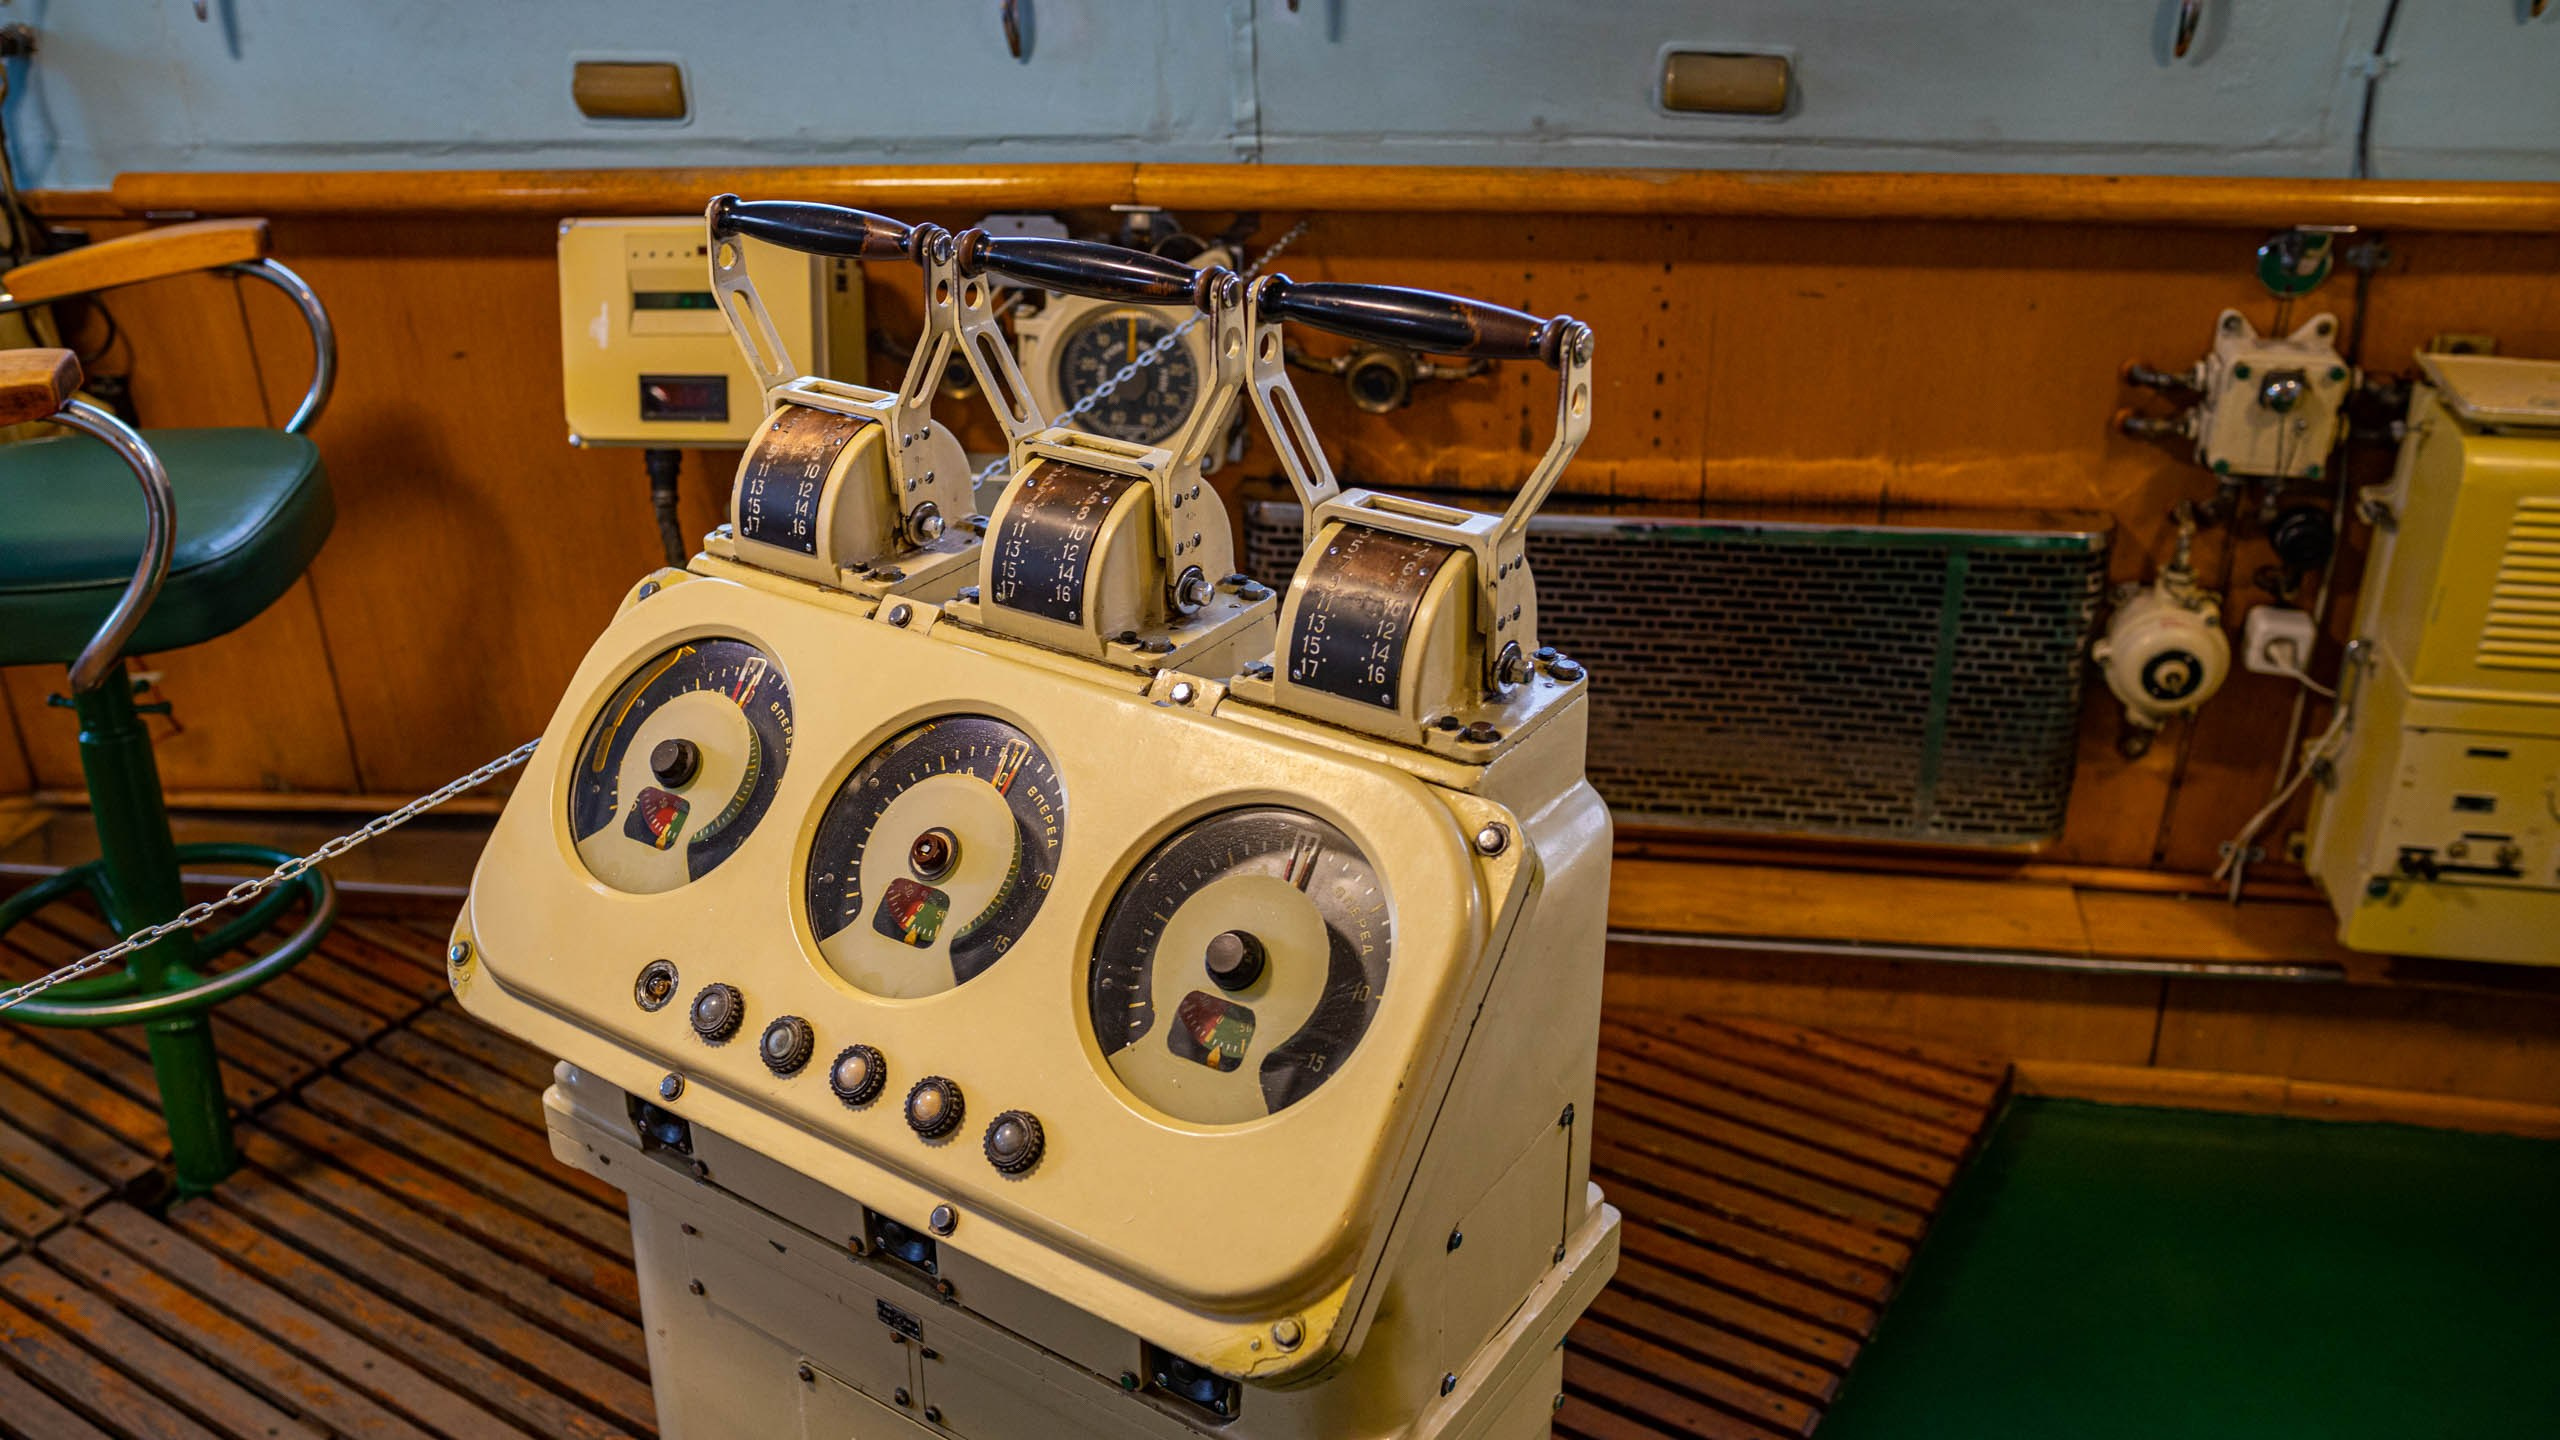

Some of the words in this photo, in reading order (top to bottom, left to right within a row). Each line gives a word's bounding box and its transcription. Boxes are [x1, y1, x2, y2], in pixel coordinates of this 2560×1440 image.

[758, 463, 769, 476] 11
[803, 463, 820, 479] 10
[751, 479, 765, 496] 13
[798, 482, 813, 498] 12
[748, 498, 761, 514] 15
[795, 500, 809, 516] 14
[1022, 503, 1034, 518] 9
[1076, 506, 1091, 520] 8
[747, 517, 760, 533] 17
[793, 518, 807, 535] 16
[1012, 522, 1026, 538] 11
[1068, 524, 1087, 541] 10
[1005, 541, 1021, 558] 13
[1062, 543, 1079, 561] 12
[1347, 539, 1363, 553] 5
[1414, 547, 1431, 560] 4
[1002, 561, 1017, 578] 15
[1058, 564, 1074, 582] 14
[1402, 562, 1417, 576] 6
[1001, 582, 1016, 598] 17
[1055, 585, 1071, 602] 16
[1383, 598, 1404, 616] 10
[1307, 613, 1327, 633] 13
[1376, 620, 1396, 641] 12
[1302, 635, 1321, 655] 15
[1371, 642, 1390, 663] 14
[1300, 659, 1318, 678] 17
[1367, 664, 1386, 684] 16
[997, 772, 1009, 787] 0
[1026, 785, 1058, 849] ВПЕРЕД
[1035, 872, 1053, 890] 10
[1333, 885, 1374, 956] ВПЕРЕД
[993, 934, 1011, 953] 15
[1306, 1052, 1327, 1073] 15
